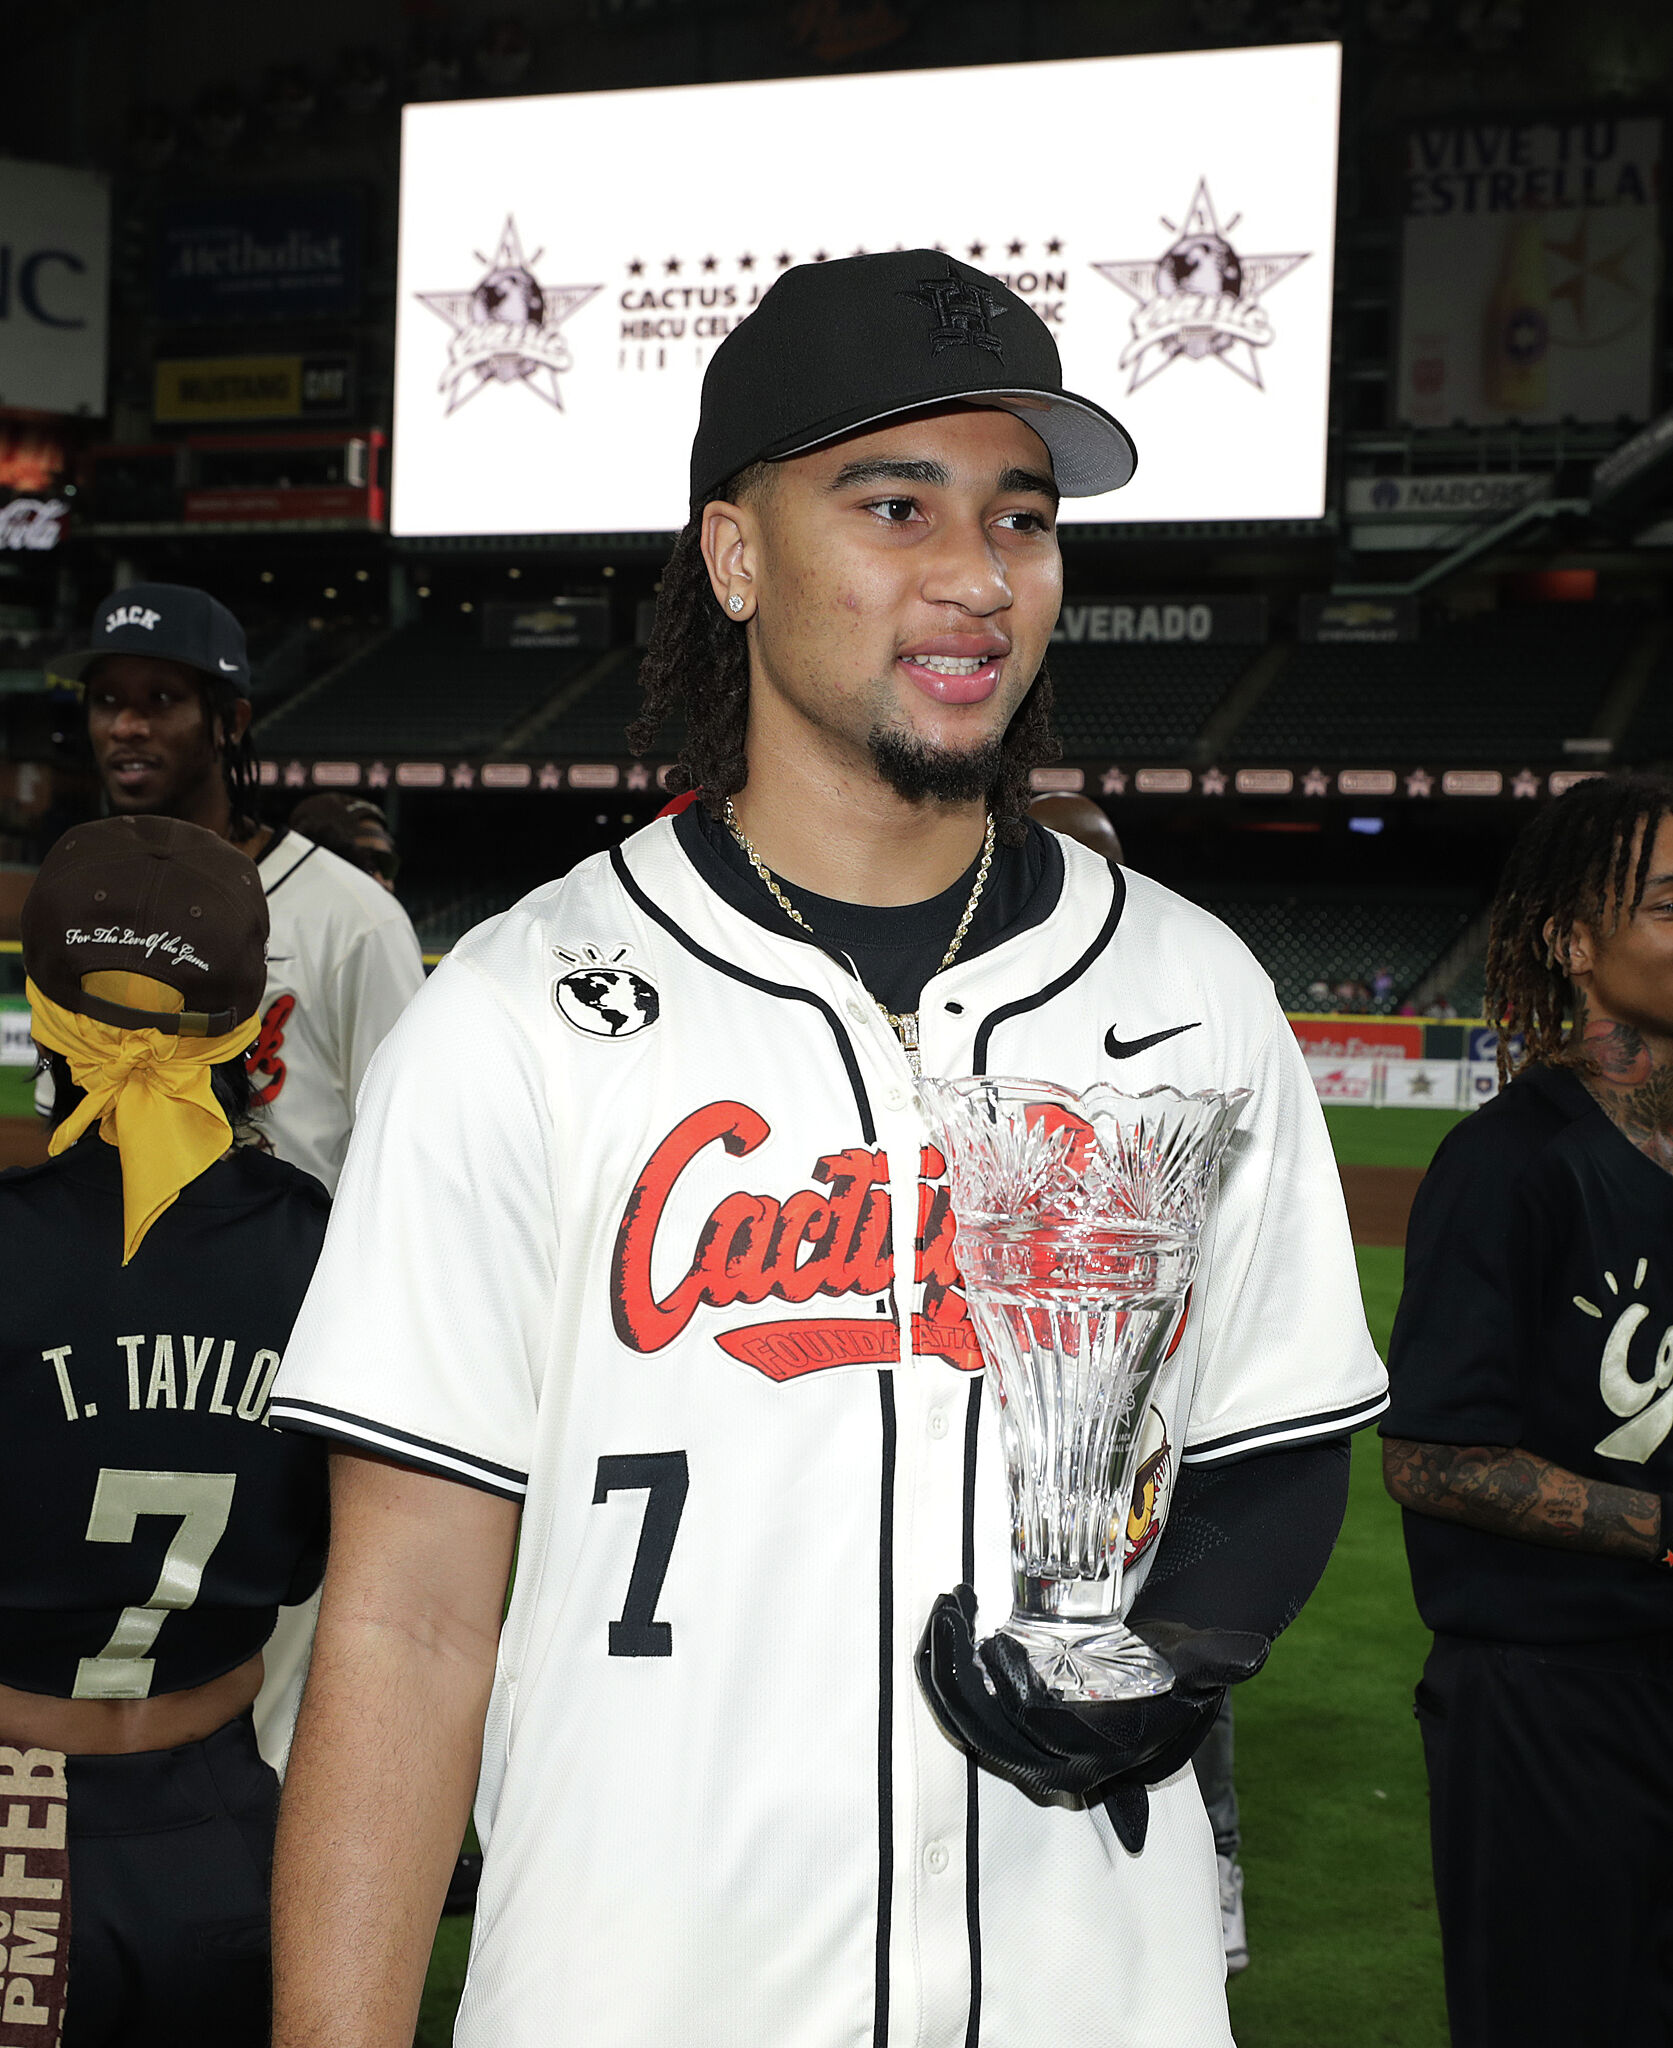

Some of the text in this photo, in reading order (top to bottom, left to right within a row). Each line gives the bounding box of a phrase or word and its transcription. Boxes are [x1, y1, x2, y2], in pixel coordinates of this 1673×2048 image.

[619, 285, 739, 313] CACTUS
[620, 318, 687, 342] HBCU
[105, 605, 162, 634] JACK
[66, 928, 91, 945] For
[92, 926, 120, 945] The
[119, 928, 146, 946] Love
[145, 931, 170, 959] Of
[160, 936, 183, 955] the
[42, 1334, 283, 1433] T. TAYLO
[592, 1450, 690, 1657] 7
[71, 1468, 237, 1700] 7
